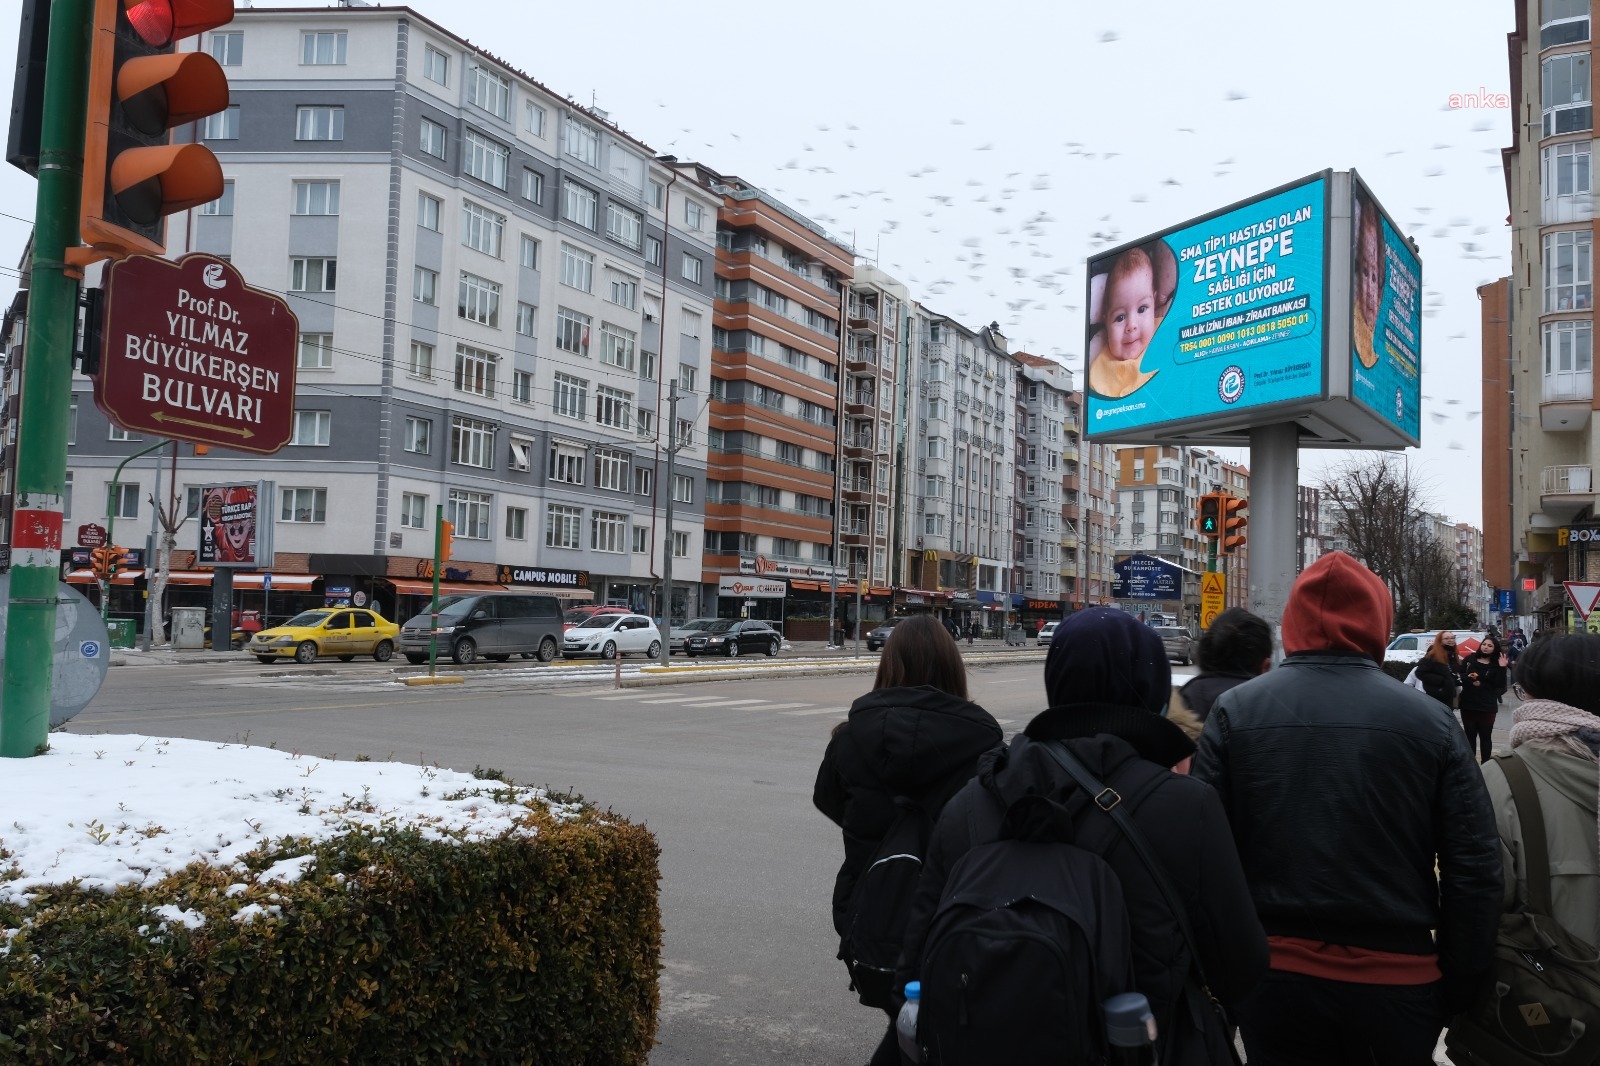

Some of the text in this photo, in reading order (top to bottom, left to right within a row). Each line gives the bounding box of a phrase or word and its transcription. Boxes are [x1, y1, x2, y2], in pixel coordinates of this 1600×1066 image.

[1180, 205, 1311, 261] SMA TİP1 HASTASI OLAN
[1193, 228, 1294, 283] ZEYNEP'E
[1192, 277, 1295, 318] DESTEK OLUYORUZ
[1207, 264, 1276, 296] SAĞLIĞI İÇİN
[166, 310, 249, 355] YILMAZ
[1180, 340, 1198, 353] TR54
[1217, 331, 1235, 344] 0090
[1256, 321, 1276, 335] 0818
[1277, 315, 1297, 329] 5050
[1298, 312, 1309, 325] 01
[1181, 323, 1205, 339] VALİLİK
[1245, 307, 1272, 323] ZİRAAT
[1271, 297, 1306, 316] BANKASI
[125, 333, 279, 394] BÜYÜKERŞEN
[142, 372, 262, 424] BULVARI
[240, 502, 252, 511] RAP
[513, 570, 577, 585] CAMPUS MOBILE
